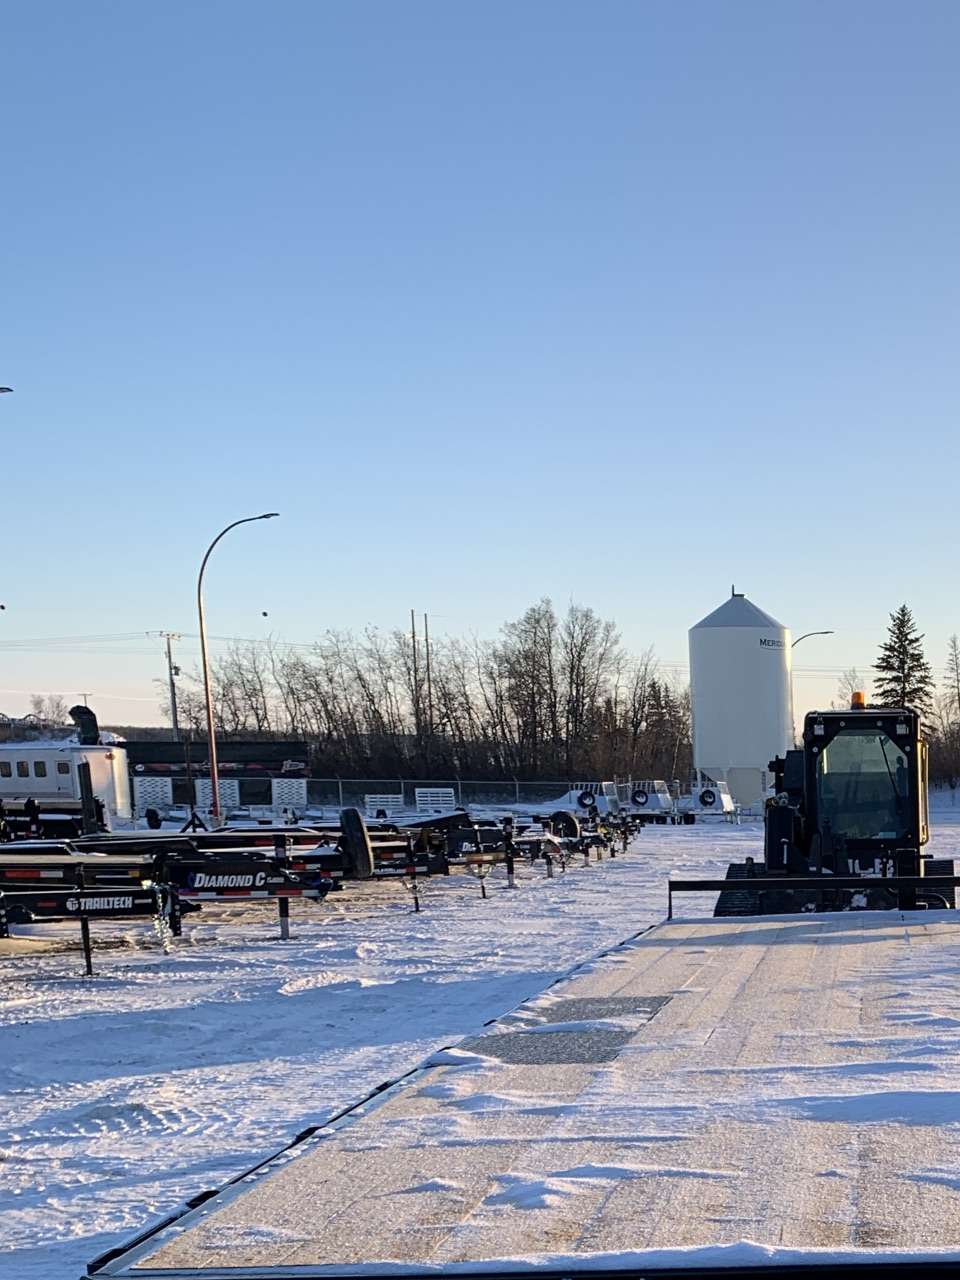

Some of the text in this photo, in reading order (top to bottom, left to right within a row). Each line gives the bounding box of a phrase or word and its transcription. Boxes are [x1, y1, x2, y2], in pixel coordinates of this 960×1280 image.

[194, 873, 252, 887] DIAMOND
[255, 872, 266, 886] C
[80, 897, 132, 910] TRAILTECH
